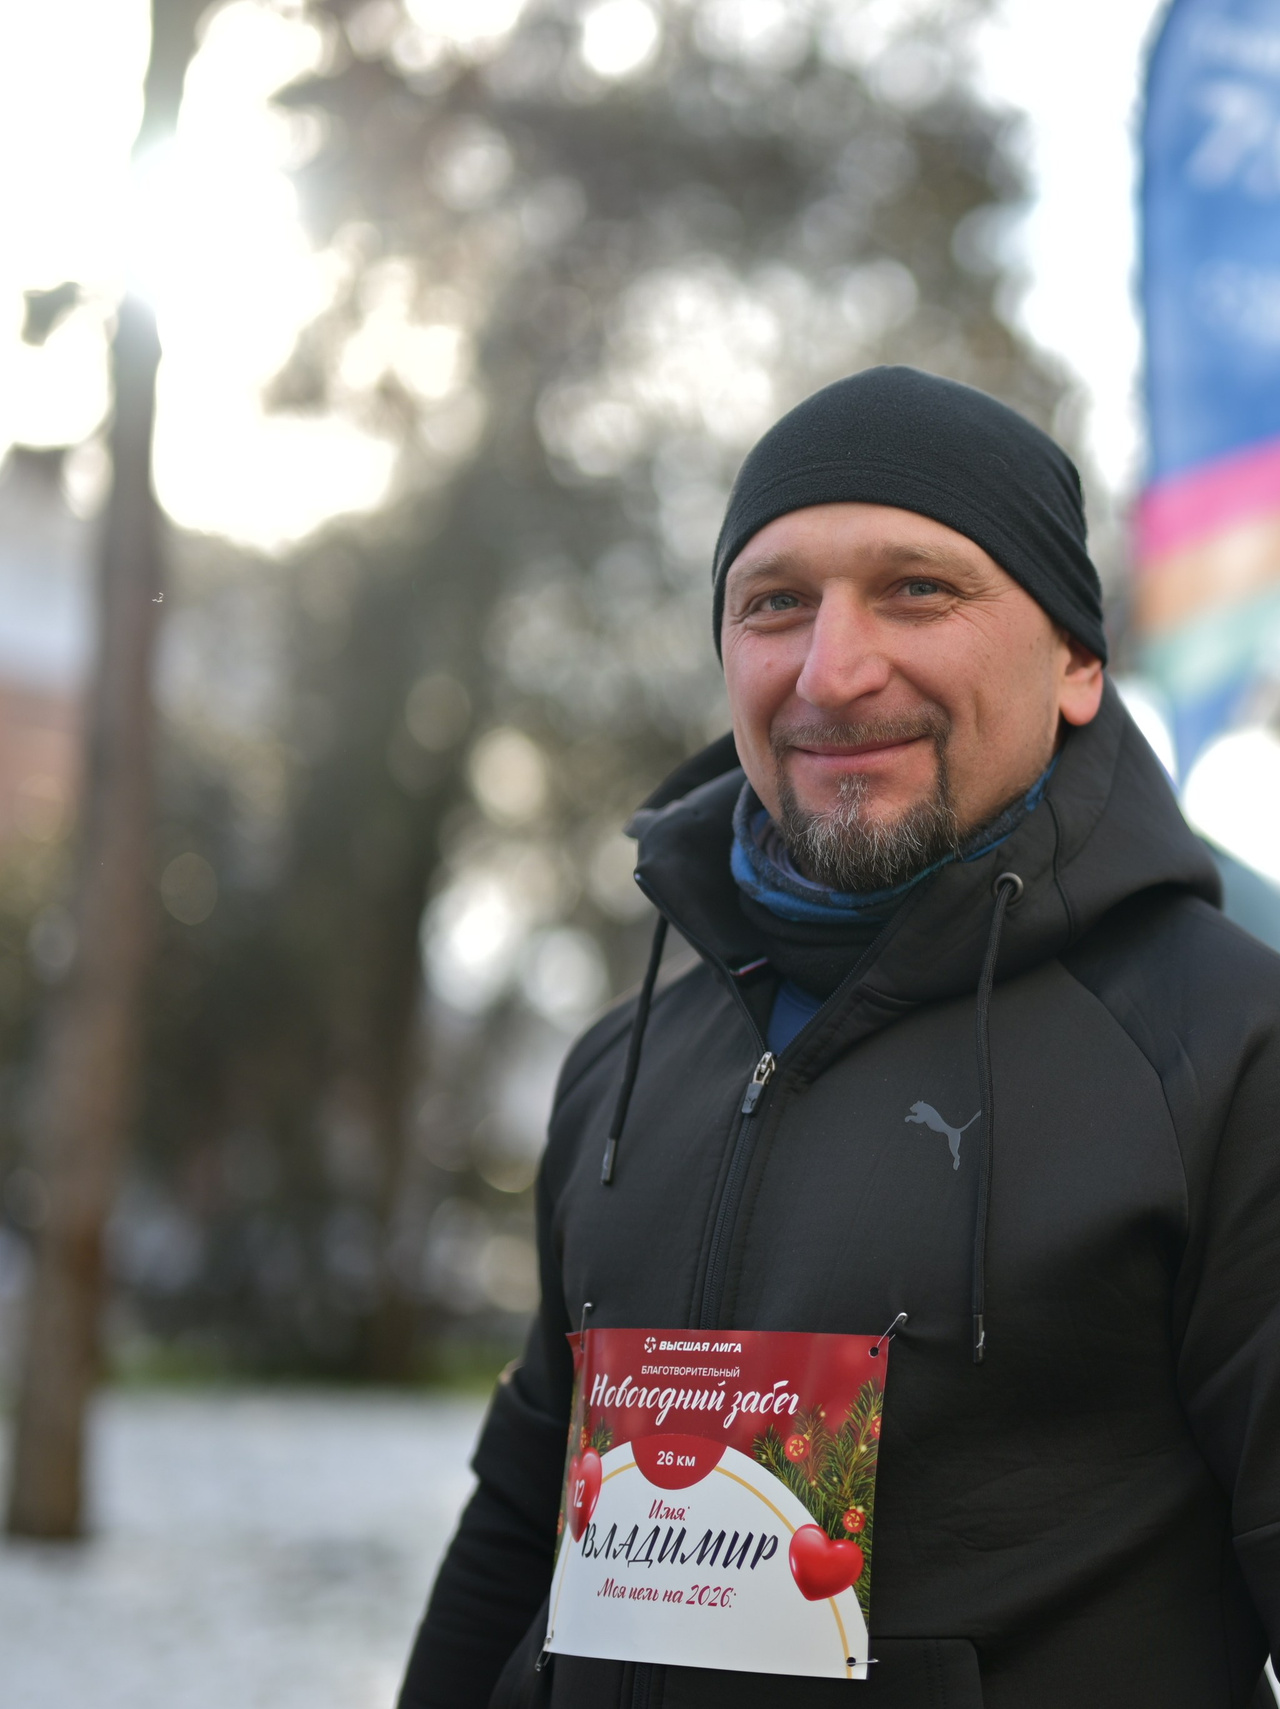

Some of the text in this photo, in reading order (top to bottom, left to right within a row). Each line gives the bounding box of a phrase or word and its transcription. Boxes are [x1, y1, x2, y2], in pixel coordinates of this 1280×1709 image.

[658, 1340, 742, 1353] ВЫСШАЯ ЛИГА
[641, 1365, 741, 1378] БЛАГОТВОРИТЕЛЬНЫЙ
[589, 1373, 800, 1429] Новогодний забег
[656, 1450, 696, 1467] 26 км
[648, 1498, 691, 1521] Имя:
[581, 1521, 779, 1570] ВЛАДИМИР
[597, 1577, 737, 1608] Моя цель на 2026:
